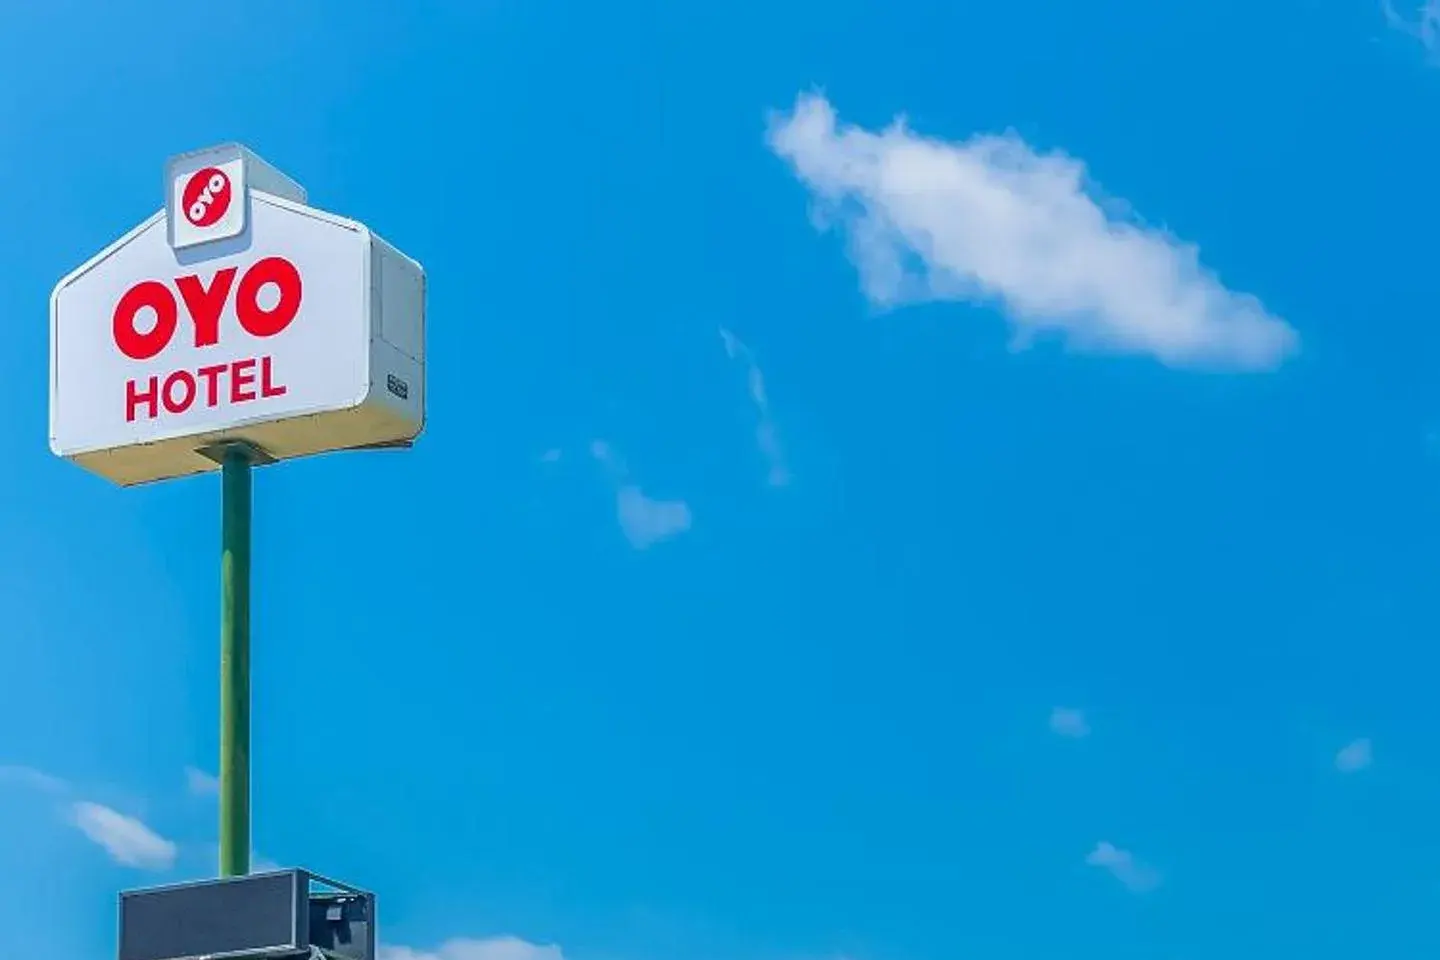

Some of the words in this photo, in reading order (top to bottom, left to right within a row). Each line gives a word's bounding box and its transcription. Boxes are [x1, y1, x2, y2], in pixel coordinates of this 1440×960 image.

[189, 172, 226, 221] OYO
[112, 256, 302, 360] OYO
[125, 356, 287, 421] HOTEL
